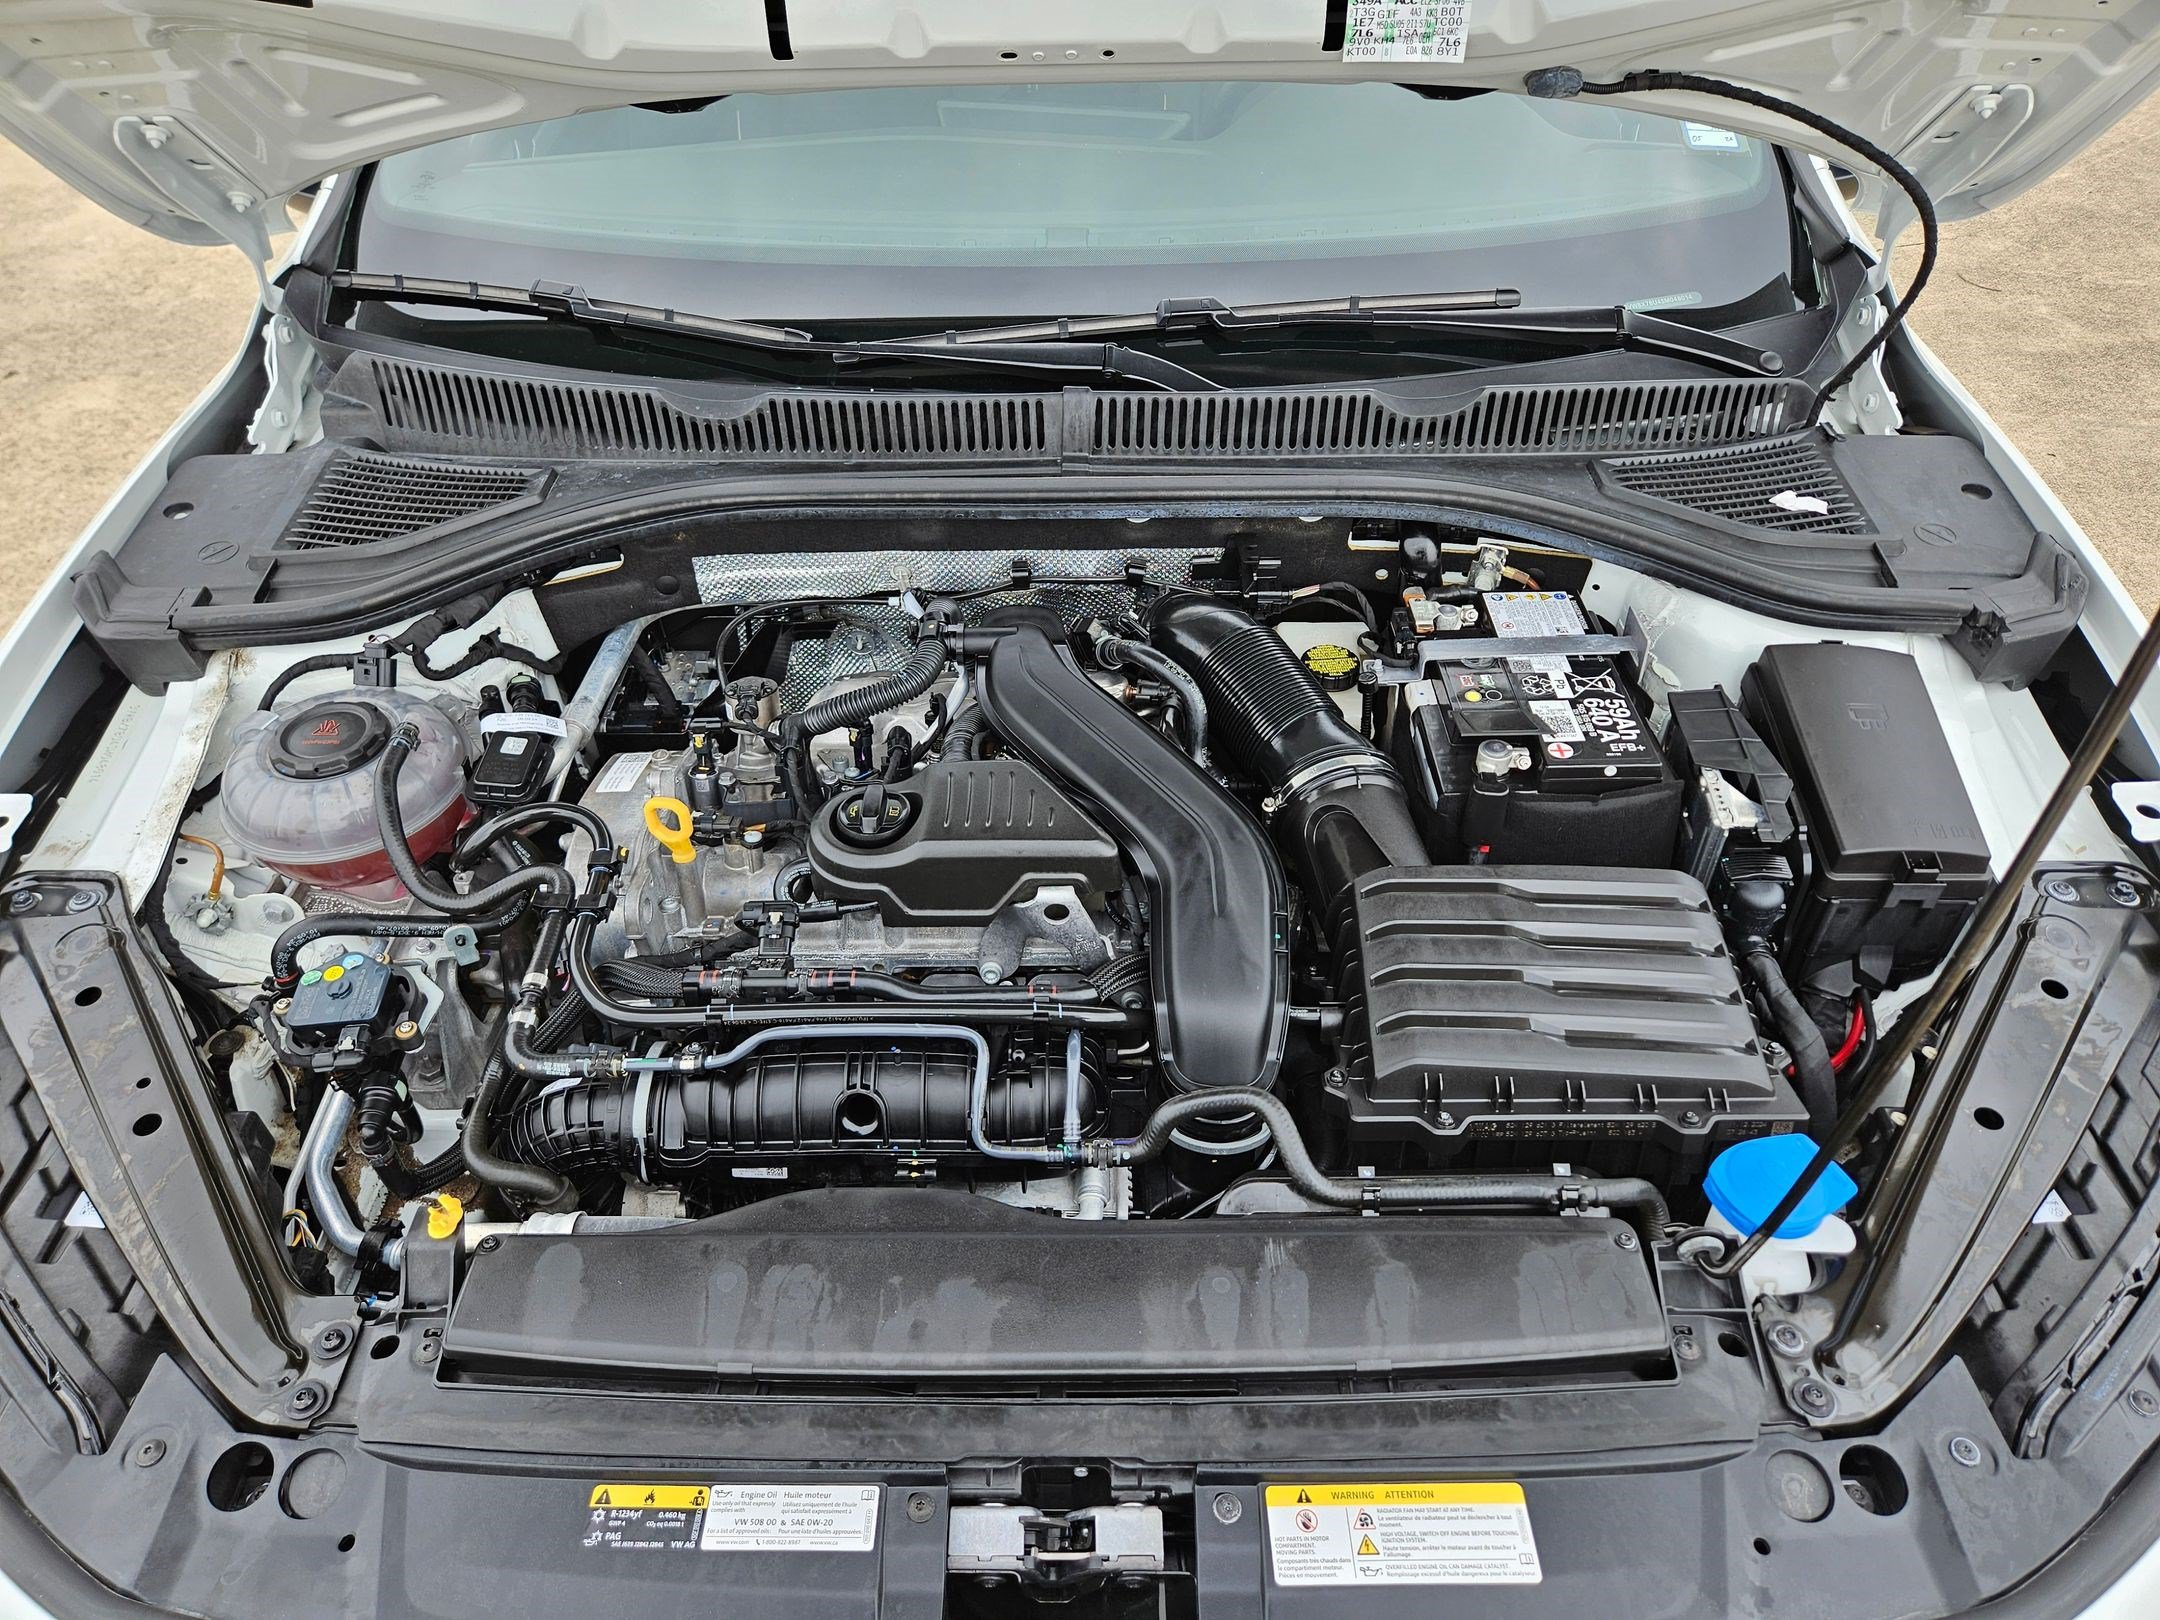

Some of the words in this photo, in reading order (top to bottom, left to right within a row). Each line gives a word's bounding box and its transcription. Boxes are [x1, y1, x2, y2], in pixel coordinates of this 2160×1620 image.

[1354, 7, 1375, 17] T3G
[1353, 17, 1374, 27] 1E7
[1352, 28, 1374, 38] 7L6
[1440, 37, 1461, 47] 7L6
[1437, 47, 1459, 56] 8Y1
[1556, 679, 1566, 691] Pb
[1583, 697, 1614, 727] 640
[1604, 698, 1642, 741] 59Ah
[1609, 742, 1647, 753] EFB+
[740, 1491, 766, 1500] Engine
[767, 1491, 778, 1499] Oil
[784, 1491, 804, 1499] Huile
[805, 1491, 832, 1499] moteur
[1330, 1491, 1375, 1500] WARNING
[1385, 1490, 1434, 1499] ATTENTION
[610, 1509, 644, 1520] R-1234yf
[658, 1511, 678, 1519] 0.460
[678, 1511, 687, 1520] kg
[734, 1518, 749, 1526] VW
[749, 1518, 765, 1526] 508
[766, 1518, 777, 1526] 00
[790, 1518, 805, 1526] SAE
[807, 1518, 834, 1526] 0W-20
[605, 1531, 622, 1541] PAG
[671, 1540, 684, 1549] VW
[684, 1540, 696, 1549] AG
[1277, 1557, 1309, 1565] Composants
